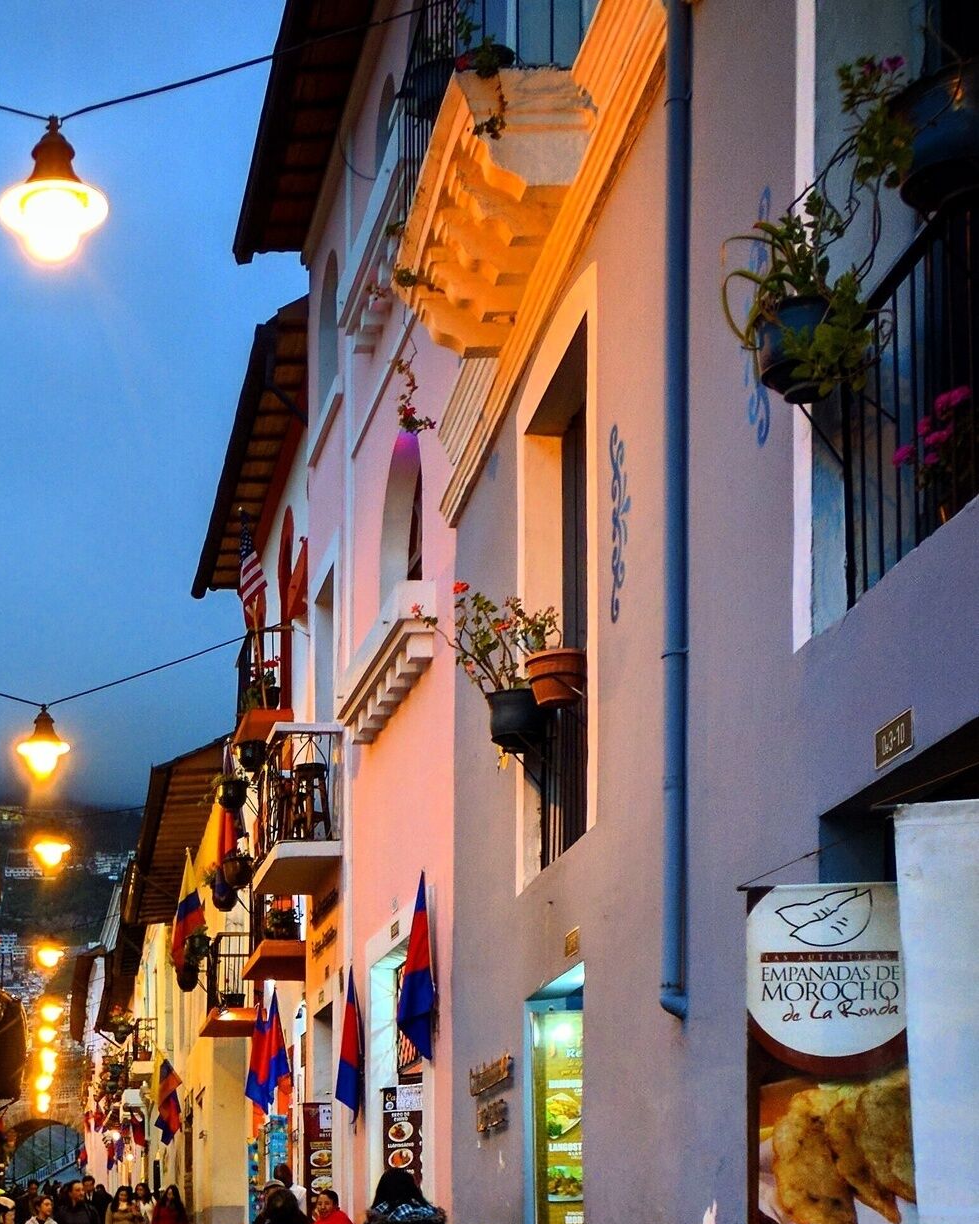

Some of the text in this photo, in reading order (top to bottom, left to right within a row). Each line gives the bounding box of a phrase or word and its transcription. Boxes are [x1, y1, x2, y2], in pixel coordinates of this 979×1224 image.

[765, 954, 788, 962] LAS
[762, 965, 900, 982] EMPANADAS DE
[762, 981, 899, 1002] MOROCHO
[782, 996, 899, 1022] de La Ronda
